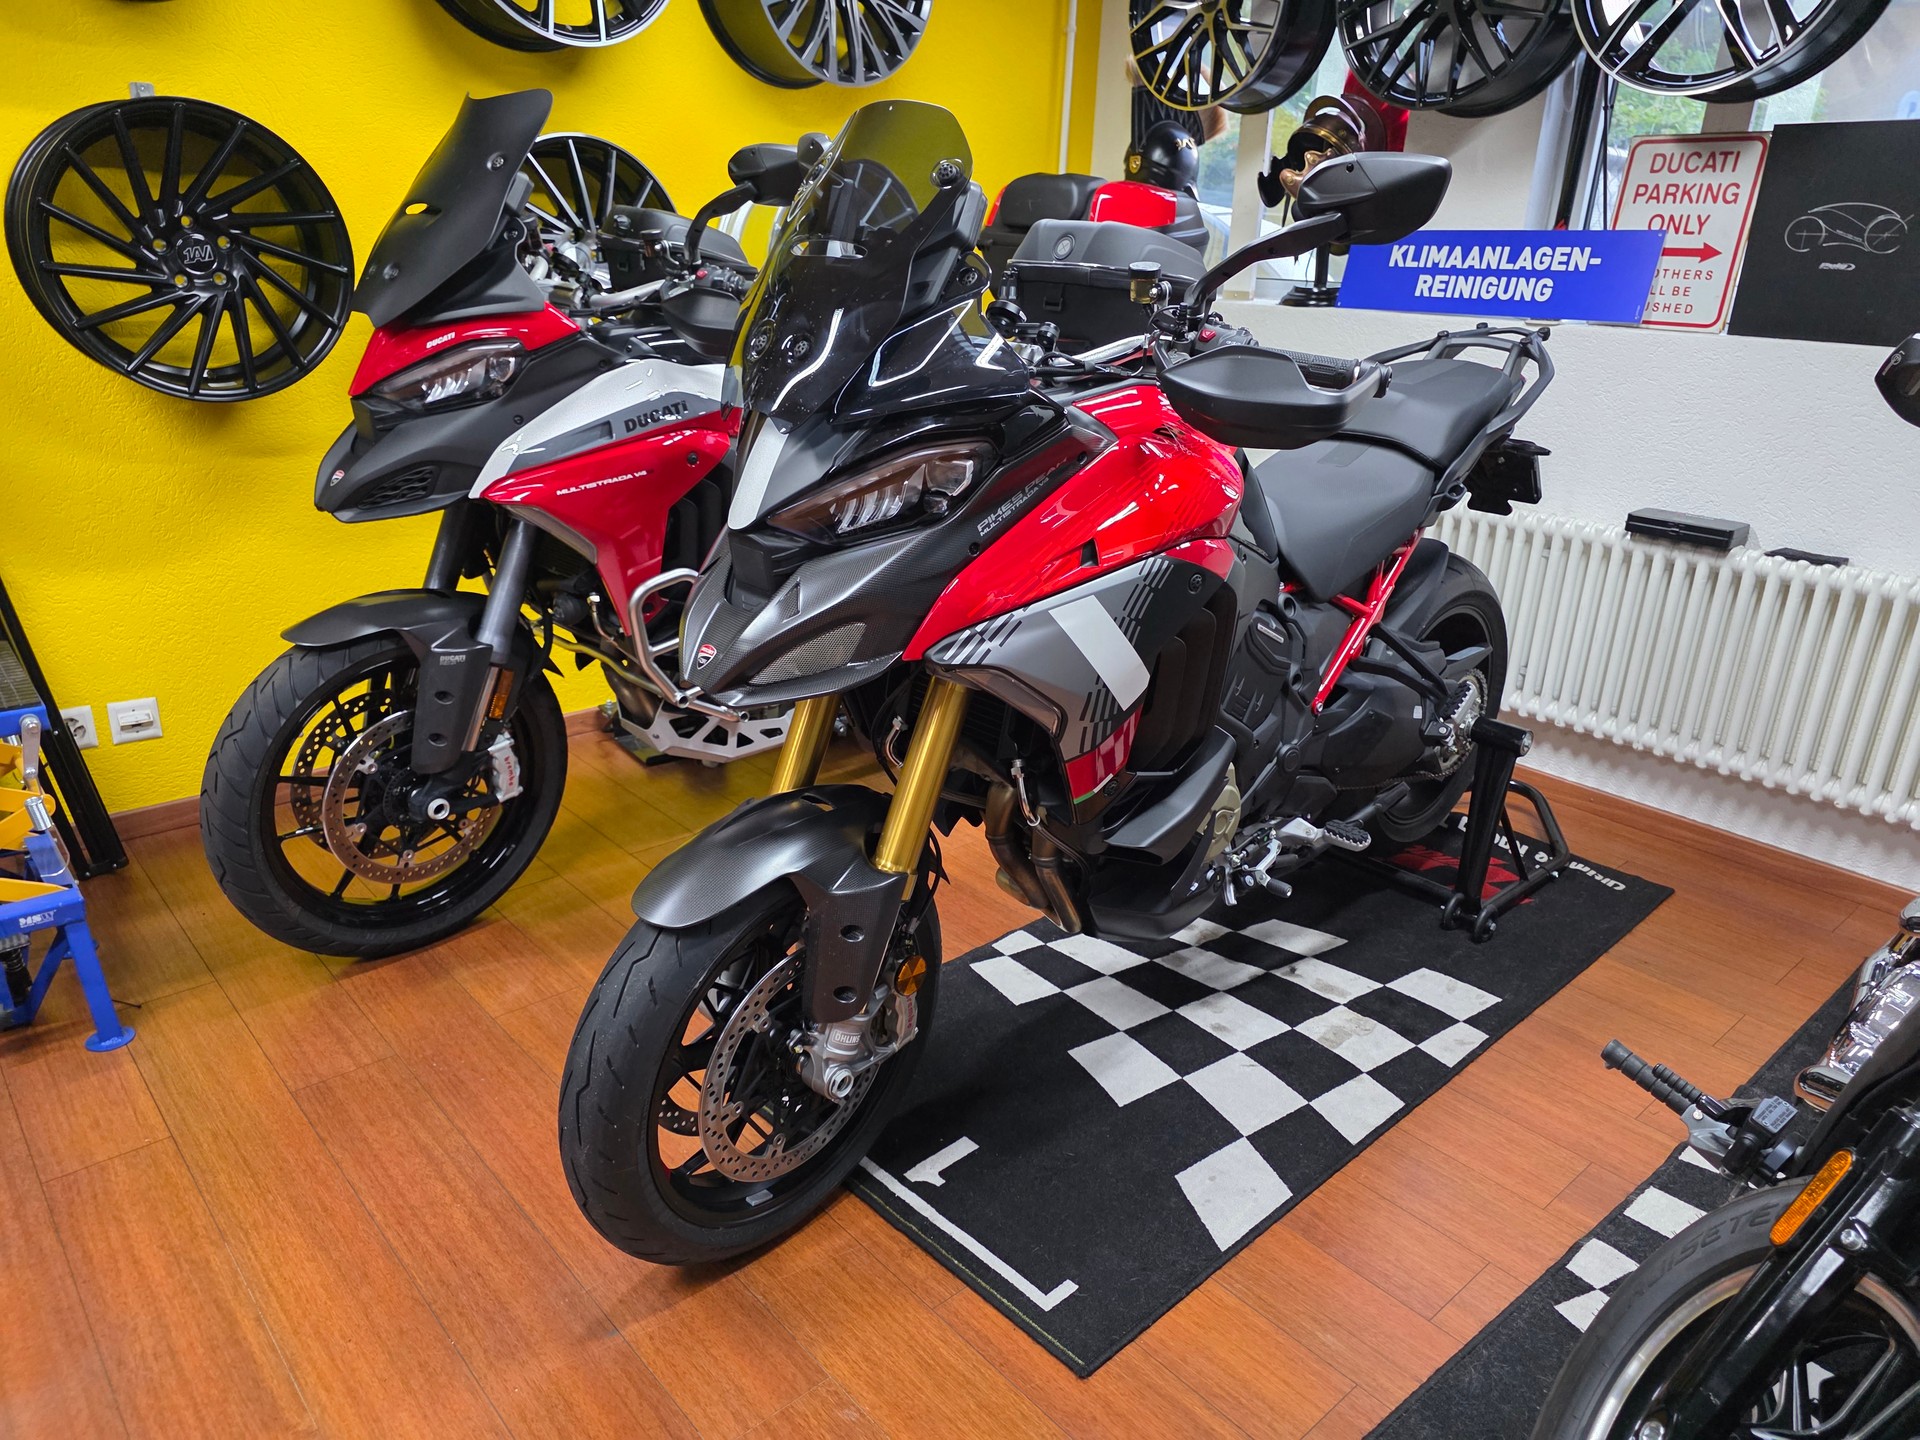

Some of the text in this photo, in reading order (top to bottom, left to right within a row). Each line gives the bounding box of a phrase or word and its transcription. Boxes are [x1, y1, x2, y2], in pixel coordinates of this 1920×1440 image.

[1650, 151, 1741, 174] DUCATI
[1633, 183, 1741, 205] PARKING
[1648, 214, 1711, 235] ONLY
[1389, 244, 1602, 272] KLIMAANLAGEN-
[1414, 274, 1554, 302] REINIGUNG
[1672, 286, 1692, 297] BE
[624, 400, 689, 433] DUCATI
[556, 474, 634, 496] MULTISTRADA
[976, 491, 1023, 532] PIKES
[980, 487, 1039, 537] MULTISTRADA
